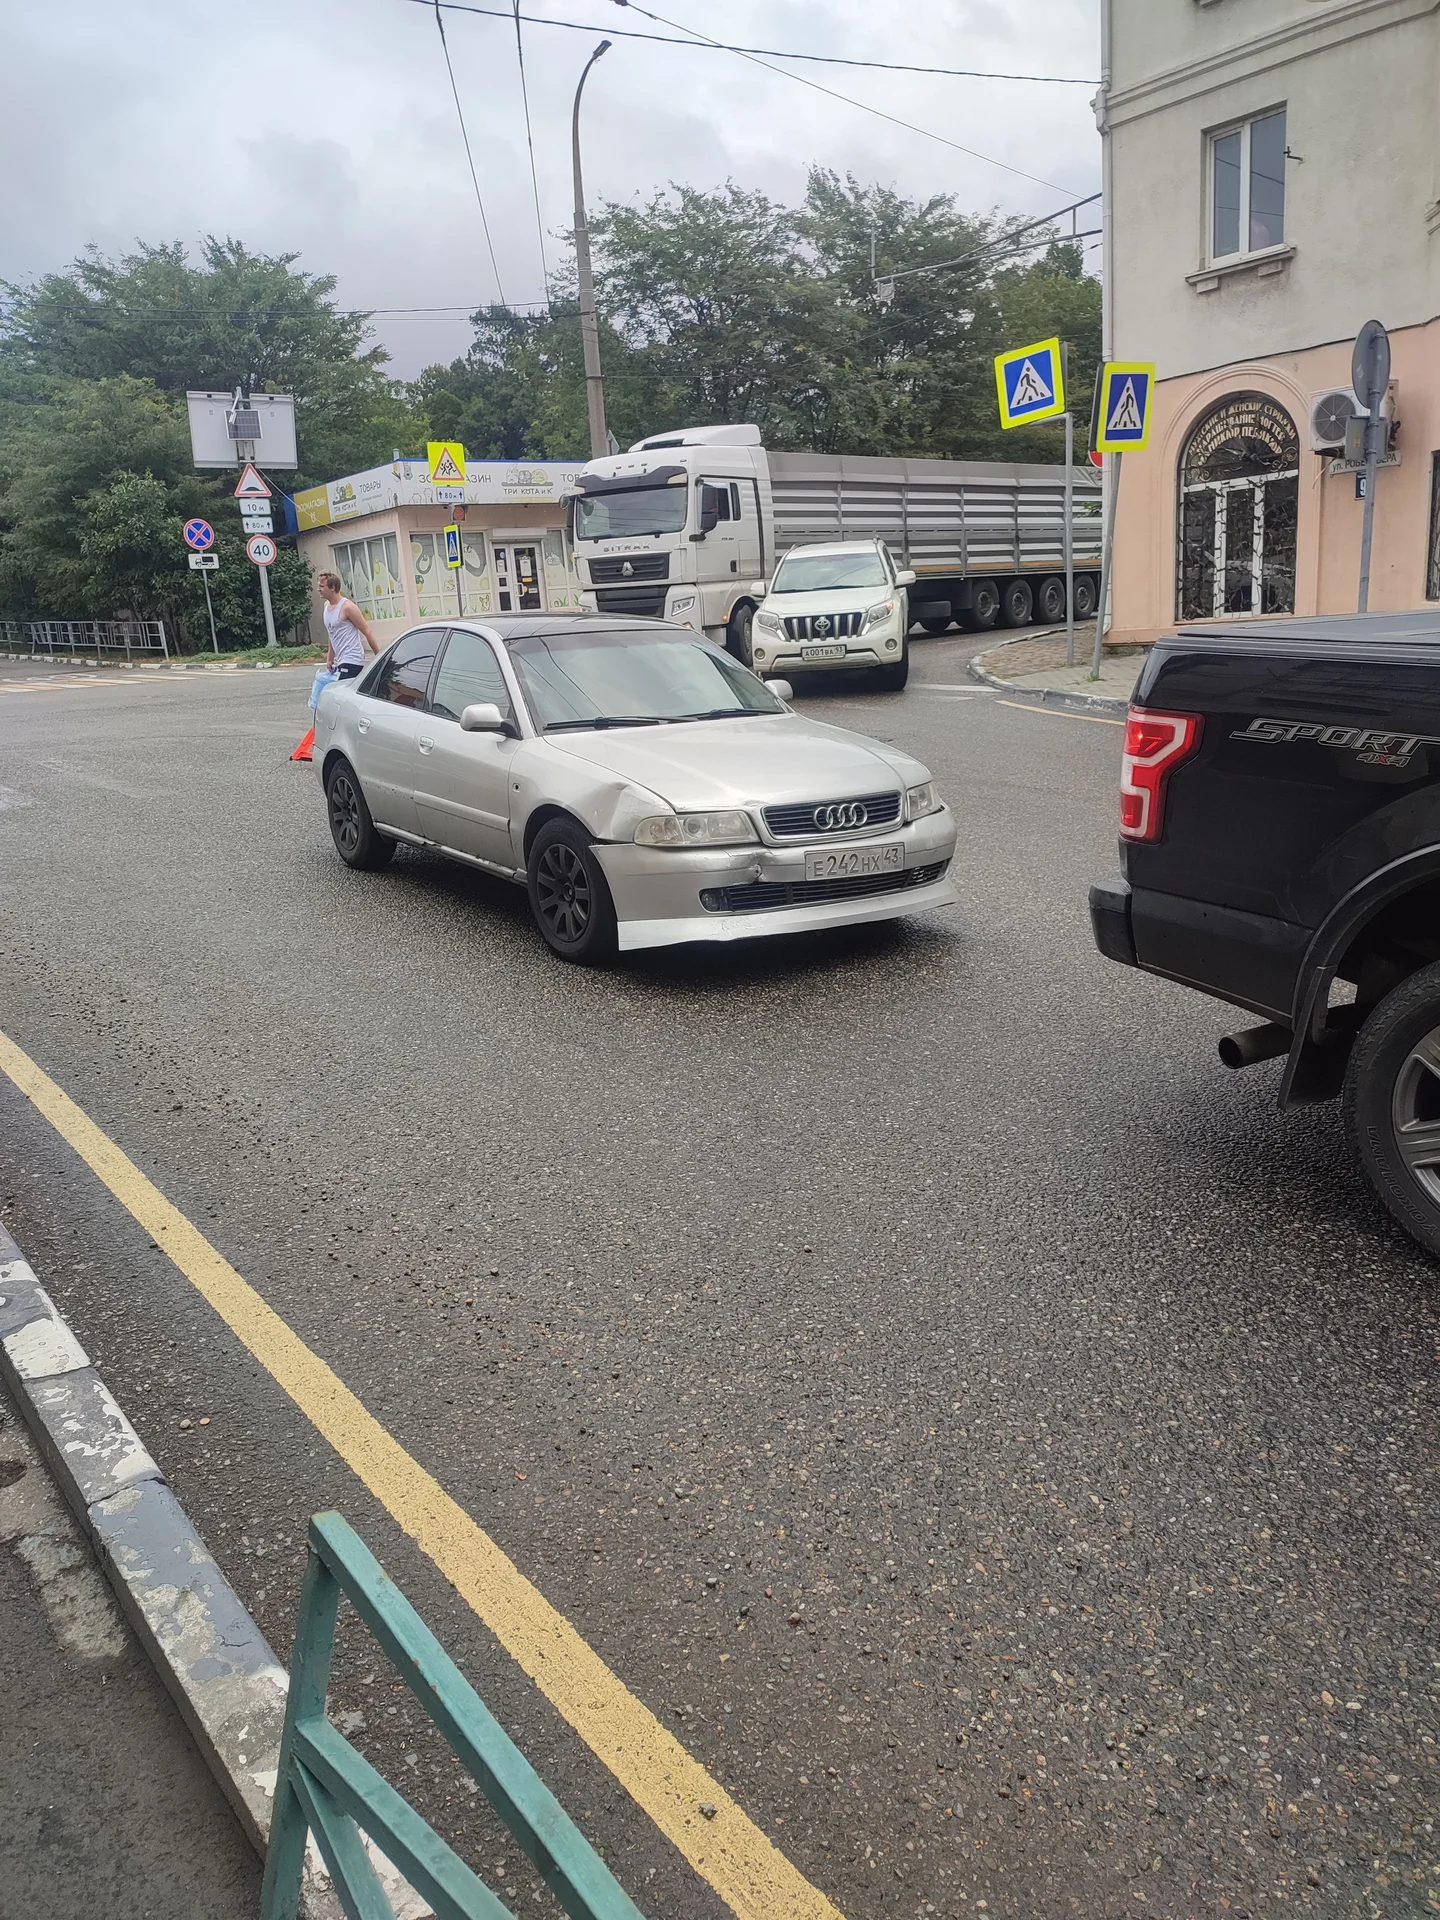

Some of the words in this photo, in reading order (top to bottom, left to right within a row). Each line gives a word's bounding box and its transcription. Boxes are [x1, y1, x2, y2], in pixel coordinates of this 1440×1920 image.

[359, 480, 382, 493] ТОВАРЫ
[247, 504, 257, 512] 10
[253, 543, 270, 556] 40
[603, 542, 650, 553] SITRAK
[1229, 717, 1440, 756] SPORT
[1366, 1125, 1438, 1236] YOKOHAMA
